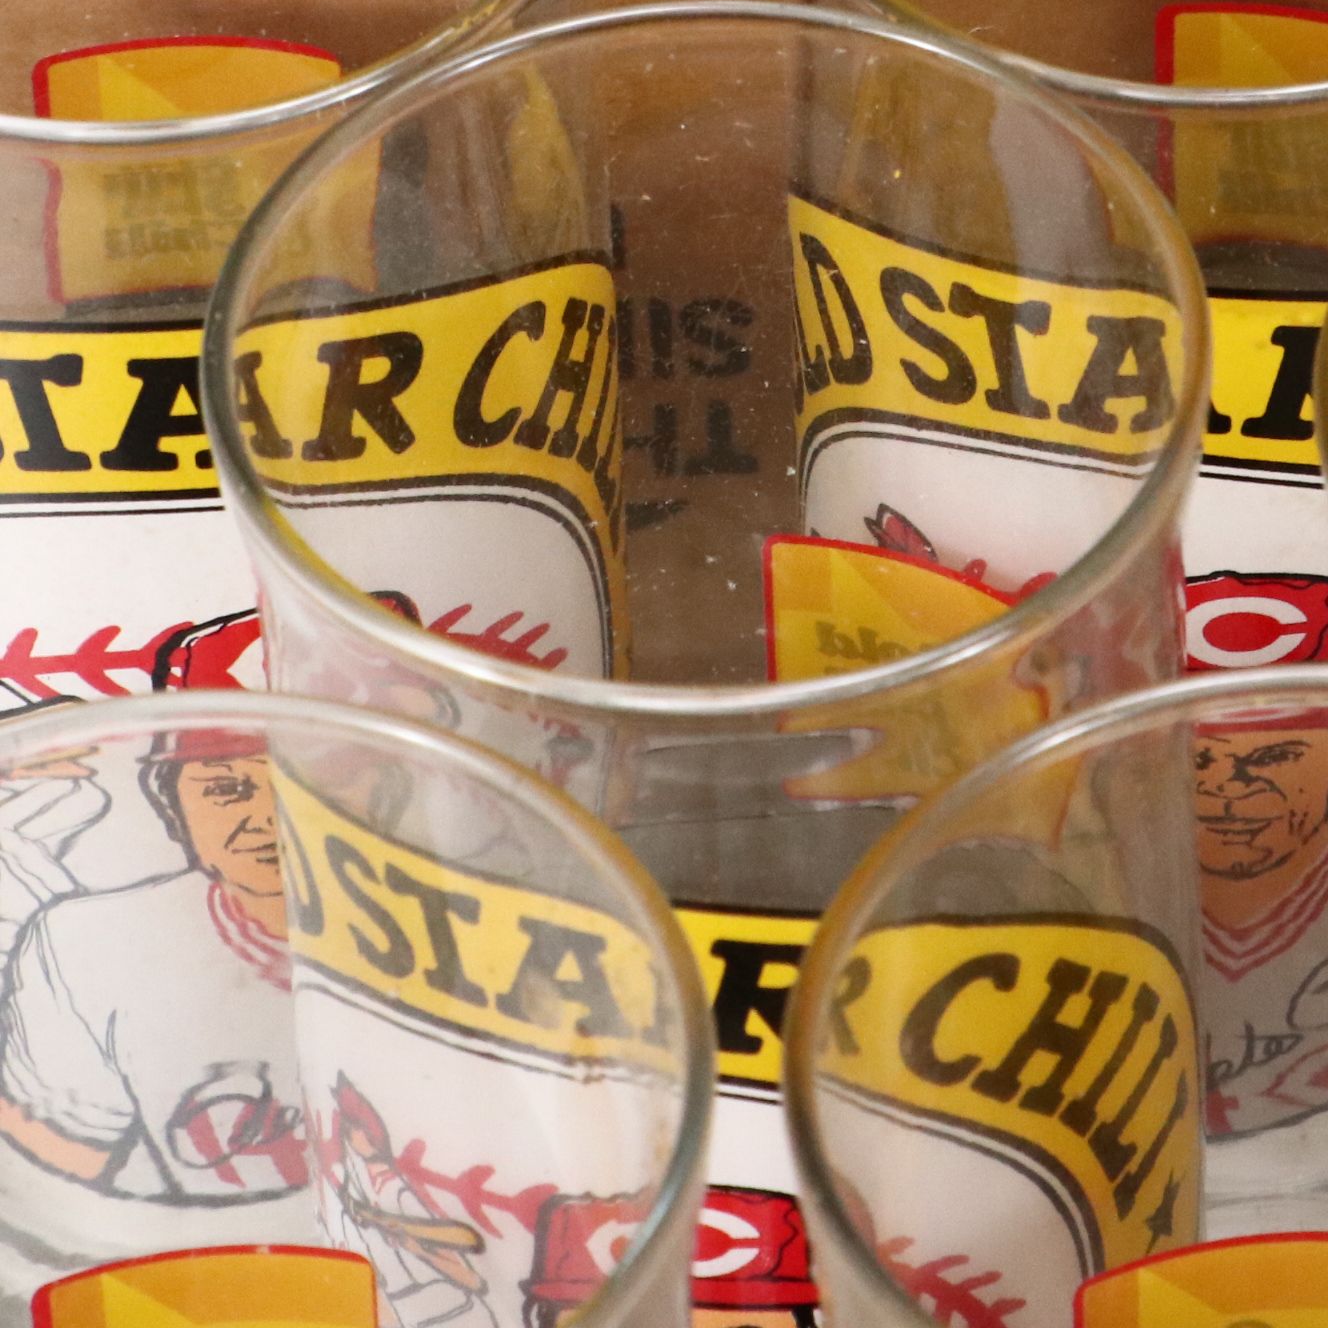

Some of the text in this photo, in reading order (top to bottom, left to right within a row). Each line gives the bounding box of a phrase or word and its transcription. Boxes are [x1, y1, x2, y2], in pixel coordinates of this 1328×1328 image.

[0, 331, 416, 472] TAR
[325, 835, 872, 1055] STAR
[900, 952, 1188, 1222] CHILI
